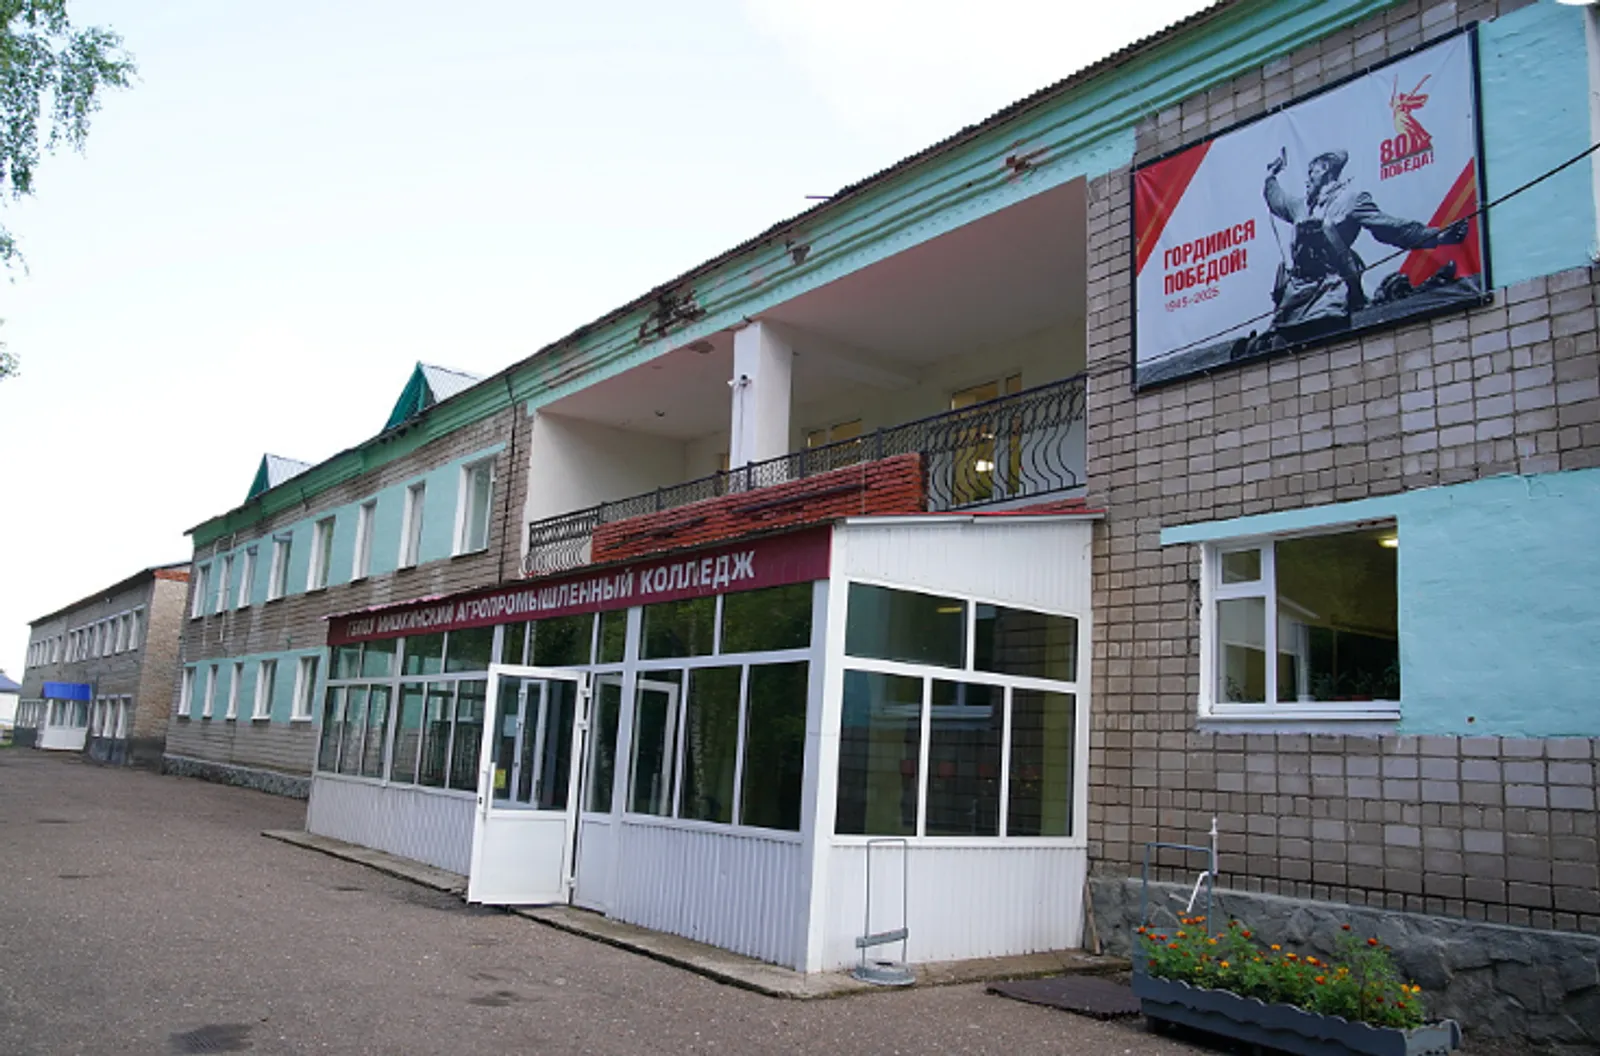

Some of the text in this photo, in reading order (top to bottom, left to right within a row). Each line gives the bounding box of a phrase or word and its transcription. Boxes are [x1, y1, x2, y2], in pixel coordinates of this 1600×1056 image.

[1380, 151, 1434, 180] ПОБЕДА!
[1164, 218, 1255, 270] ГОРДИМСЯ
[1164, 248, 1248, 295] ПОБЕДОЙ!
[456, 567, 634, 621] АГРОПРОМЫШЛЕННЫЙ
[640, 550, 756, 595] КОЛЛЕДЖ
